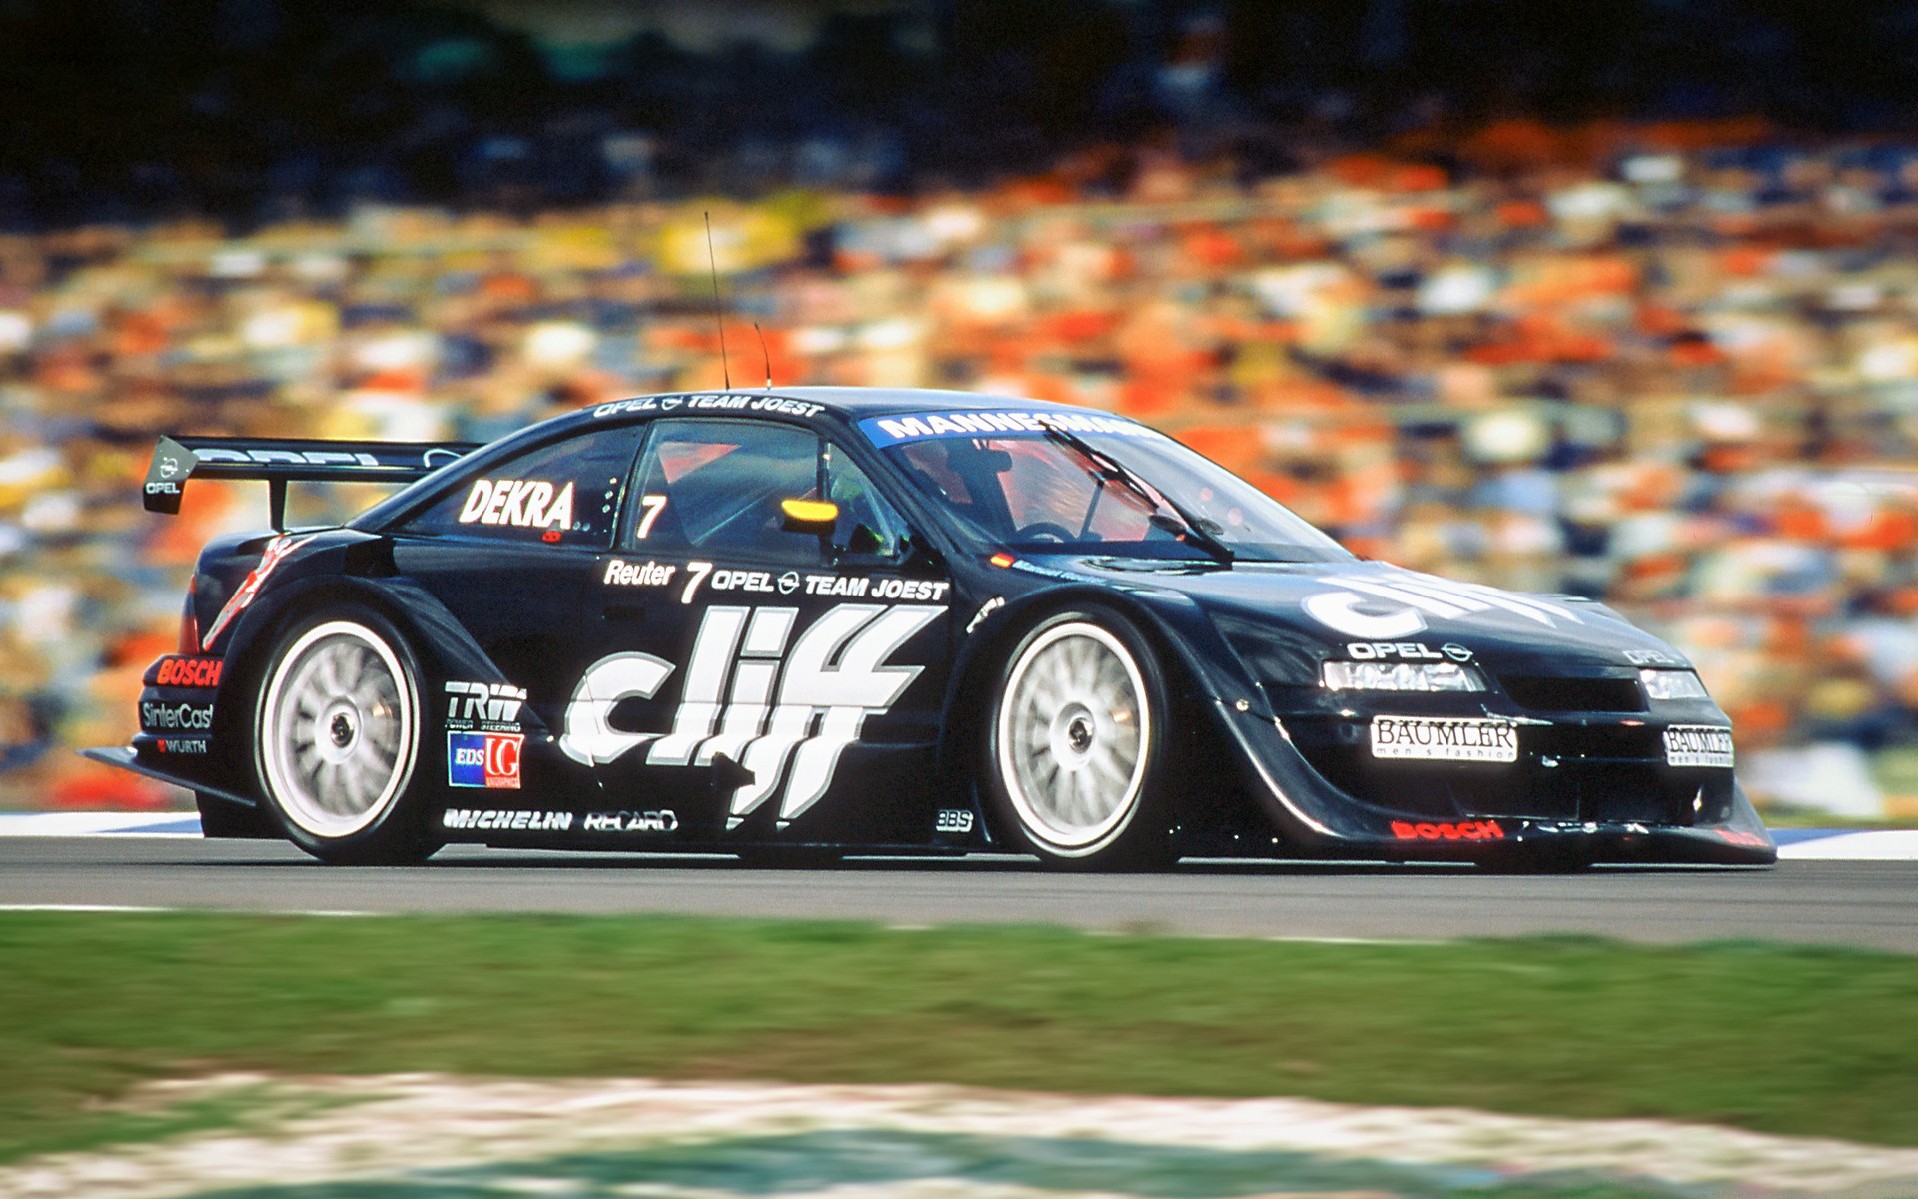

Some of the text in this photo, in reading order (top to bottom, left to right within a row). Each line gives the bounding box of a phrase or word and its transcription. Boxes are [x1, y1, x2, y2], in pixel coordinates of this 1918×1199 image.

[593, 395, 825, 418] OPEL TEAM JOEST
[146, 482, 180, 495] OPEL
[459, 480, 574, 530] DEKRA
[636, 495, 667, 539] 7
[604, 560, 949, 604] Reuter 7 OPEL TEAM JOEST
[1347, 642, 1443, 661] OPEL
[156, 659, 223, 686] BOSCH
[445, 681, 527, 722] TRW
[143, 702, 214, 729] SinterCast
[559, 603, 949, 832] cliff
[455, 748, 485, 766] EDS
[443, 808, 573, 831] MICHELIN
[583, 810, 679, 831] RECARO
[936, 809, 974, 833] BBS
[1391, 820, 1505, 840] BOSCH
